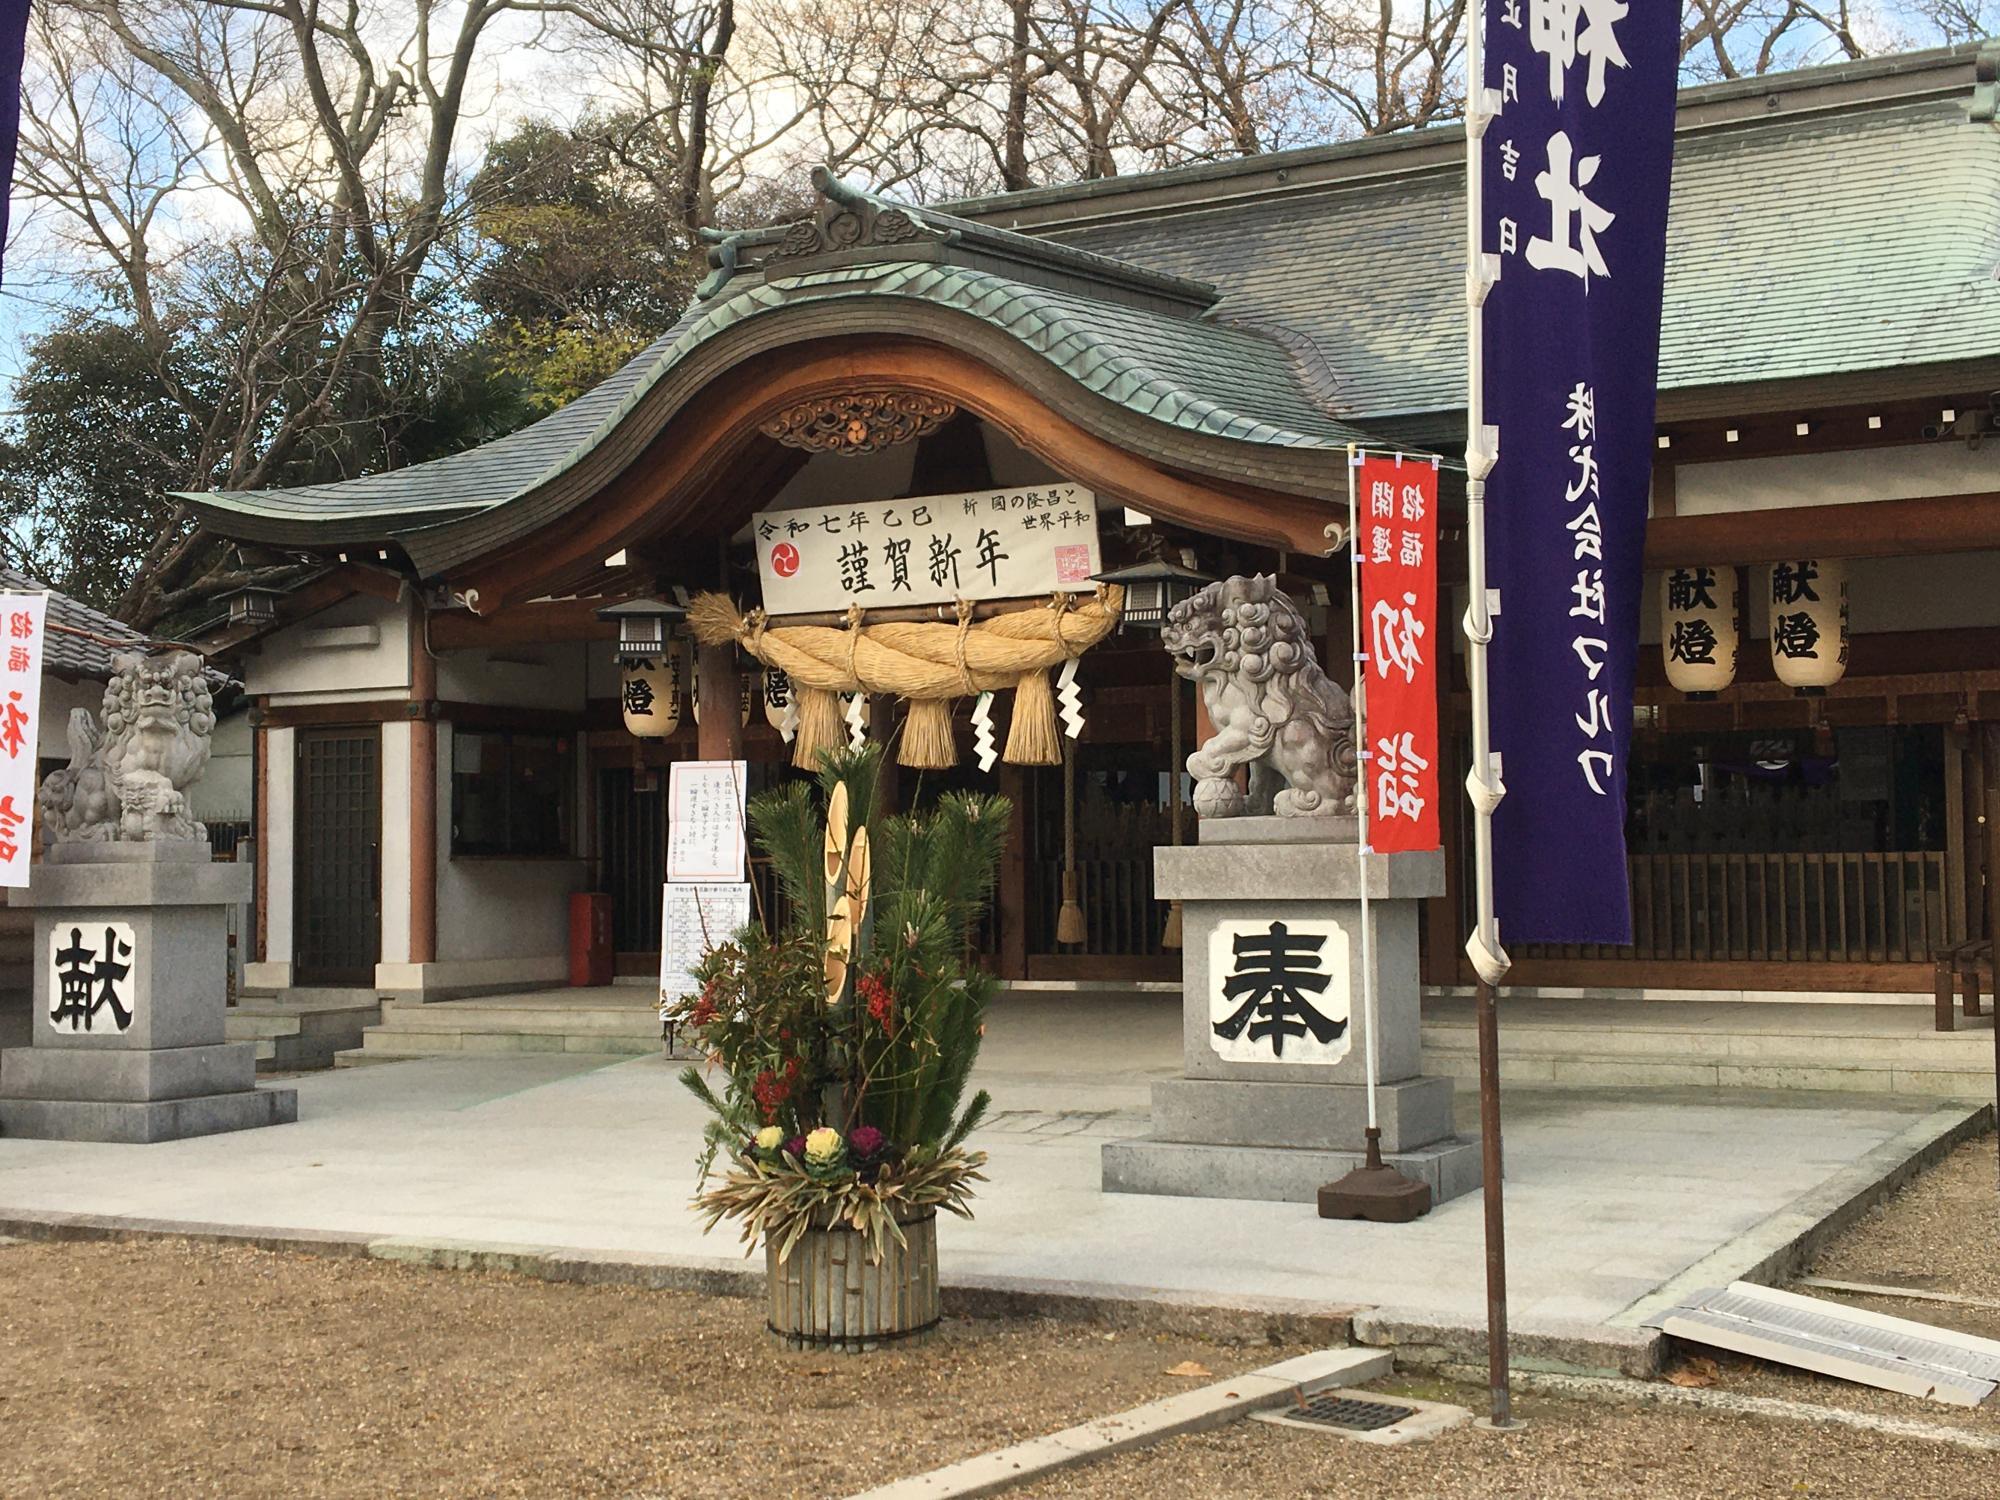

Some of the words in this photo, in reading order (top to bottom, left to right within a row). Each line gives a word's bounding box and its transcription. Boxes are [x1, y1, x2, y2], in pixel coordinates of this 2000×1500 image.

[836, 528, 1009, 595] 謹賀新年
[1021, 510, 1091, 533] 世界平和
[50, 926, 133, 1031] 献
[1212, 920, 1348, 1058] 奉
